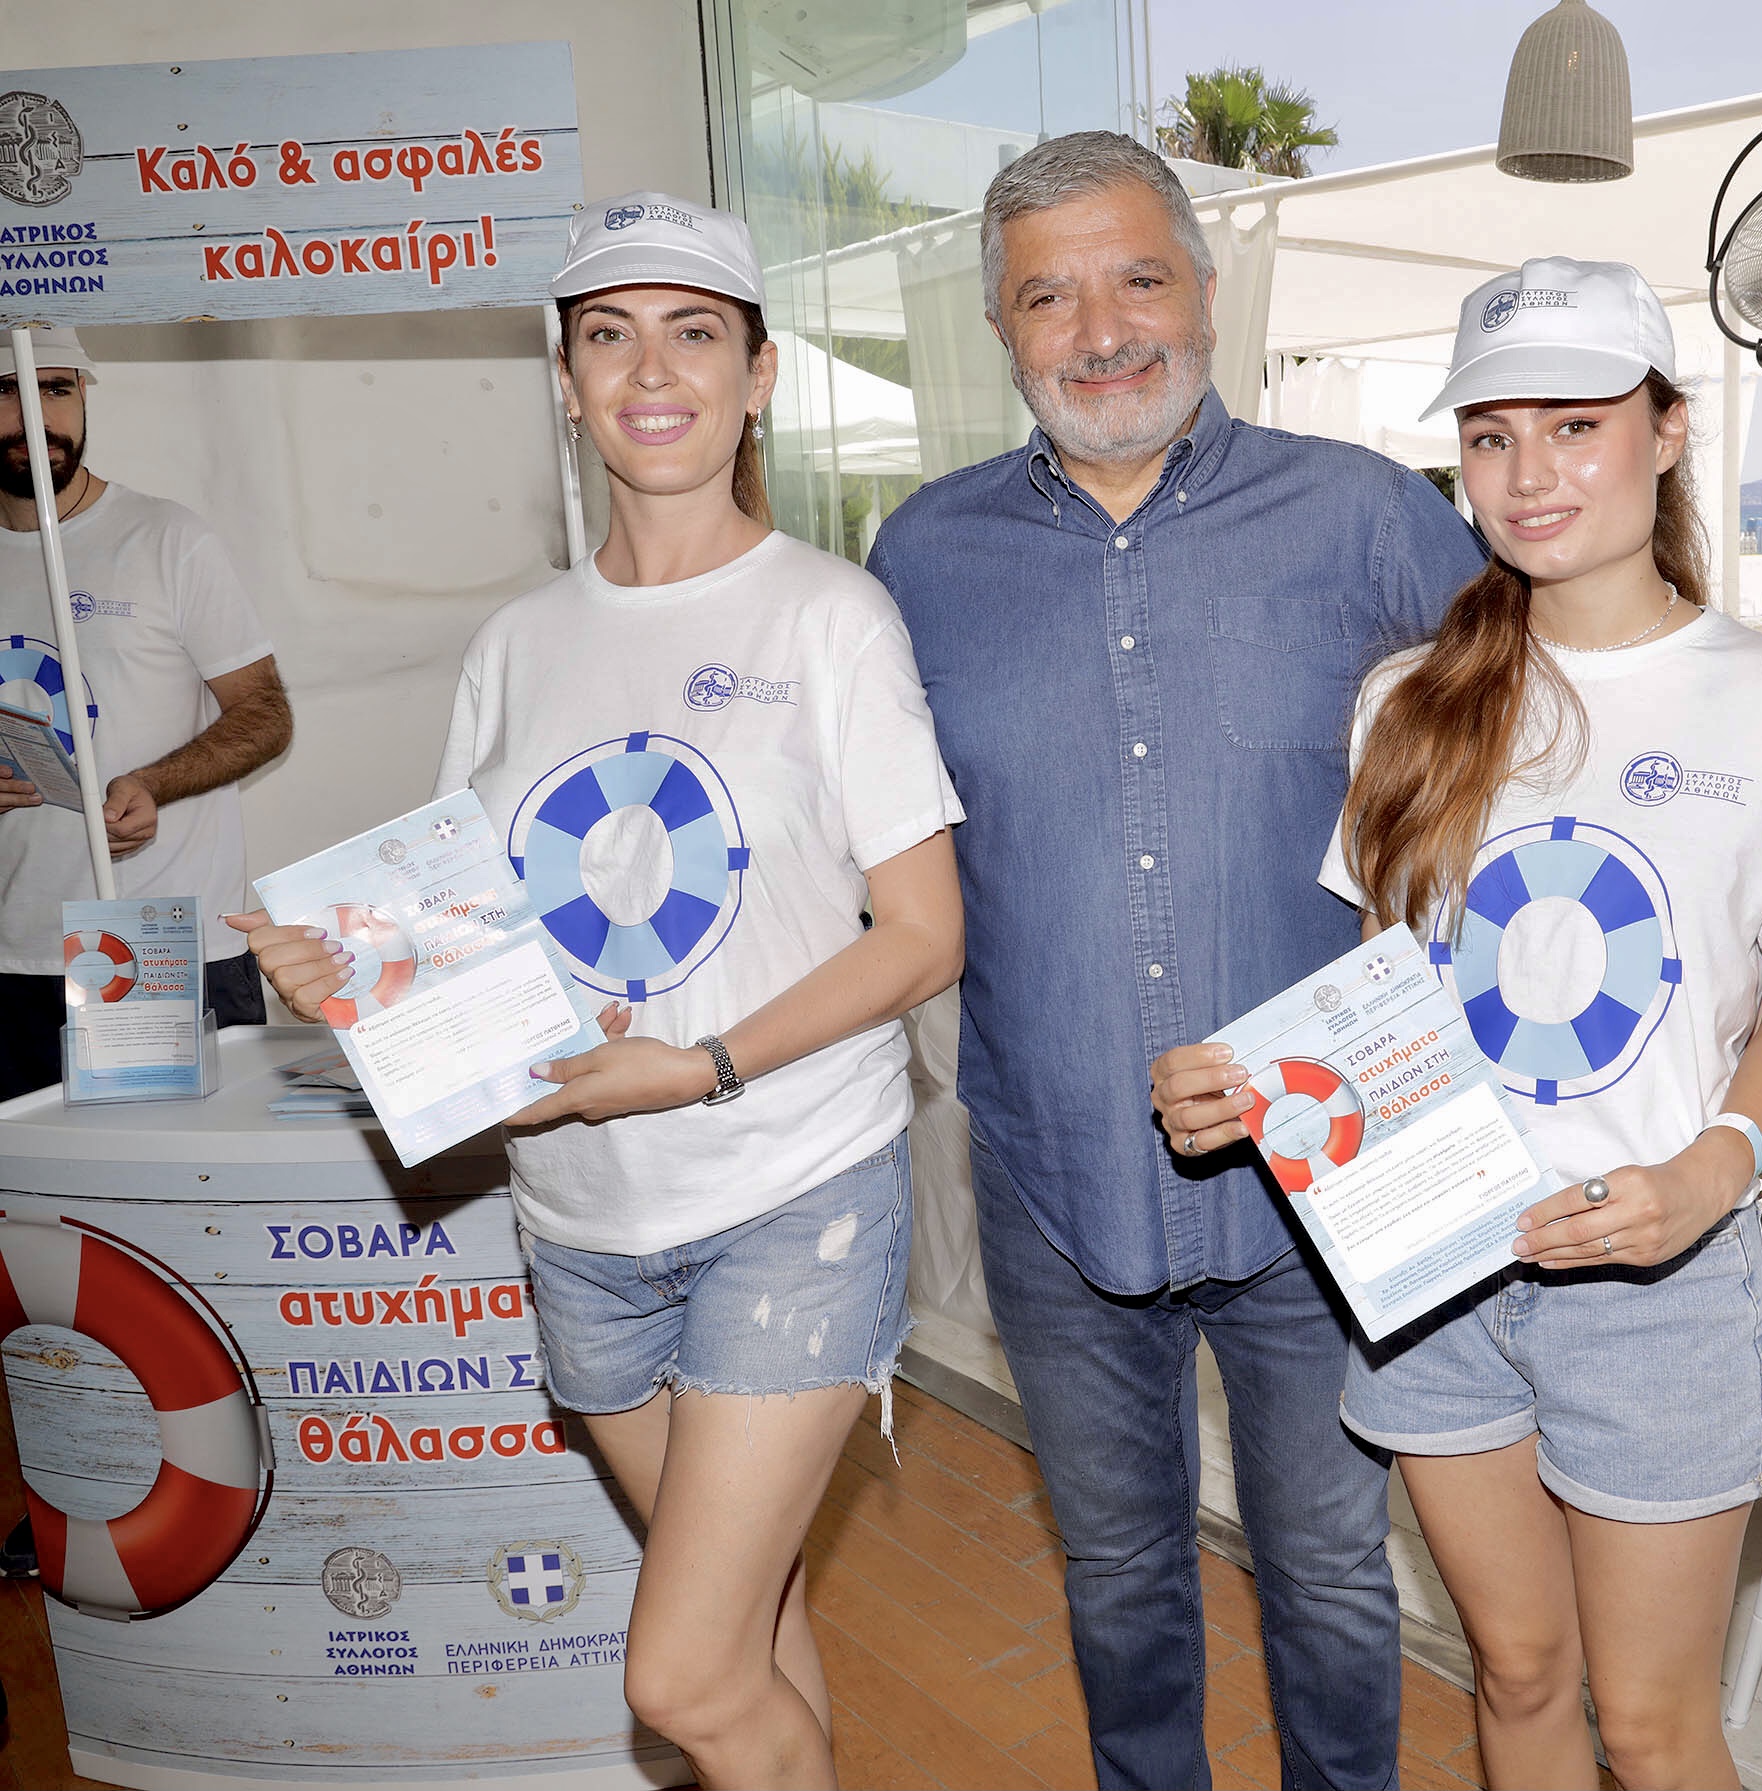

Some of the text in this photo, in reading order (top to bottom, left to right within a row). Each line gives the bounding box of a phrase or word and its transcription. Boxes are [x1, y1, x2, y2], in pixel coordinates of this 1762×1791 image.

[137, 128, 543, 194] Καλό & ασφαλές
[0, 222, 97, 244] ΑΤΡΙΚΟΣ
[0, 247, 109, 270] ΥΛΛΟΓΟΣ
[204, 215, 497, 286] καλοκαίρι!
[0, 275, 104, 297] ΑΘΗΝΩΝ
[740, 679, 791, 689] ΙΑΤΡΙΚΟΣ
[740, 685, 789, 696] ΣΥΛΛΟΓΟΣ
[739, 691, 788, 701] ΑΘΗΝΩΝ
[1685, 780, 1741, 793] ΣΥΛΛΟΓΟΣ
[1686, 773, 1742, 785] ΙΑΤΡΙΚΟΣ
[1684, 786, 1739, 800] ΑΘΗΝΩΝ
[480, 907, 507, 925] ΣΤΗ
[144, 983, 185, 992] θάλασσα
[1347, 1033, 1397, 1066] ΣΟΒΑΡΑ
[1359, 1030, 1439, 1083] ατυχήματα
[1368, 1049, 1450, 1102] ΠΑΙΔΙΩΝ ΣΤΗ
[1379, 1073, 1451, 1120] θάλασσα
[267, 1222, 455, 1259] ΣΟΒΑΡΑ
[287, 1354, 536, 1394] ΠΑΙΔΙΩΝ Σ
[299, 1416, 567, 1464] θάλασσα
[328, 1630, 411, 1643] ΙΑΤΡΙΚΟΣ
[445, 1631, 627, 1658] ΕΛΛΗΝΙΚΗ ΔΗΜΟΚΡΑΤ
[326, 1646, 419, 1659] ΣΥΛΛΟΓΟΣ
[334, 1663, 415, 1676] ΑΘΗΝΩΝ
[447, 1658, 560, 1675] ΠΕΡΙΦΕΡΕΙΑ
